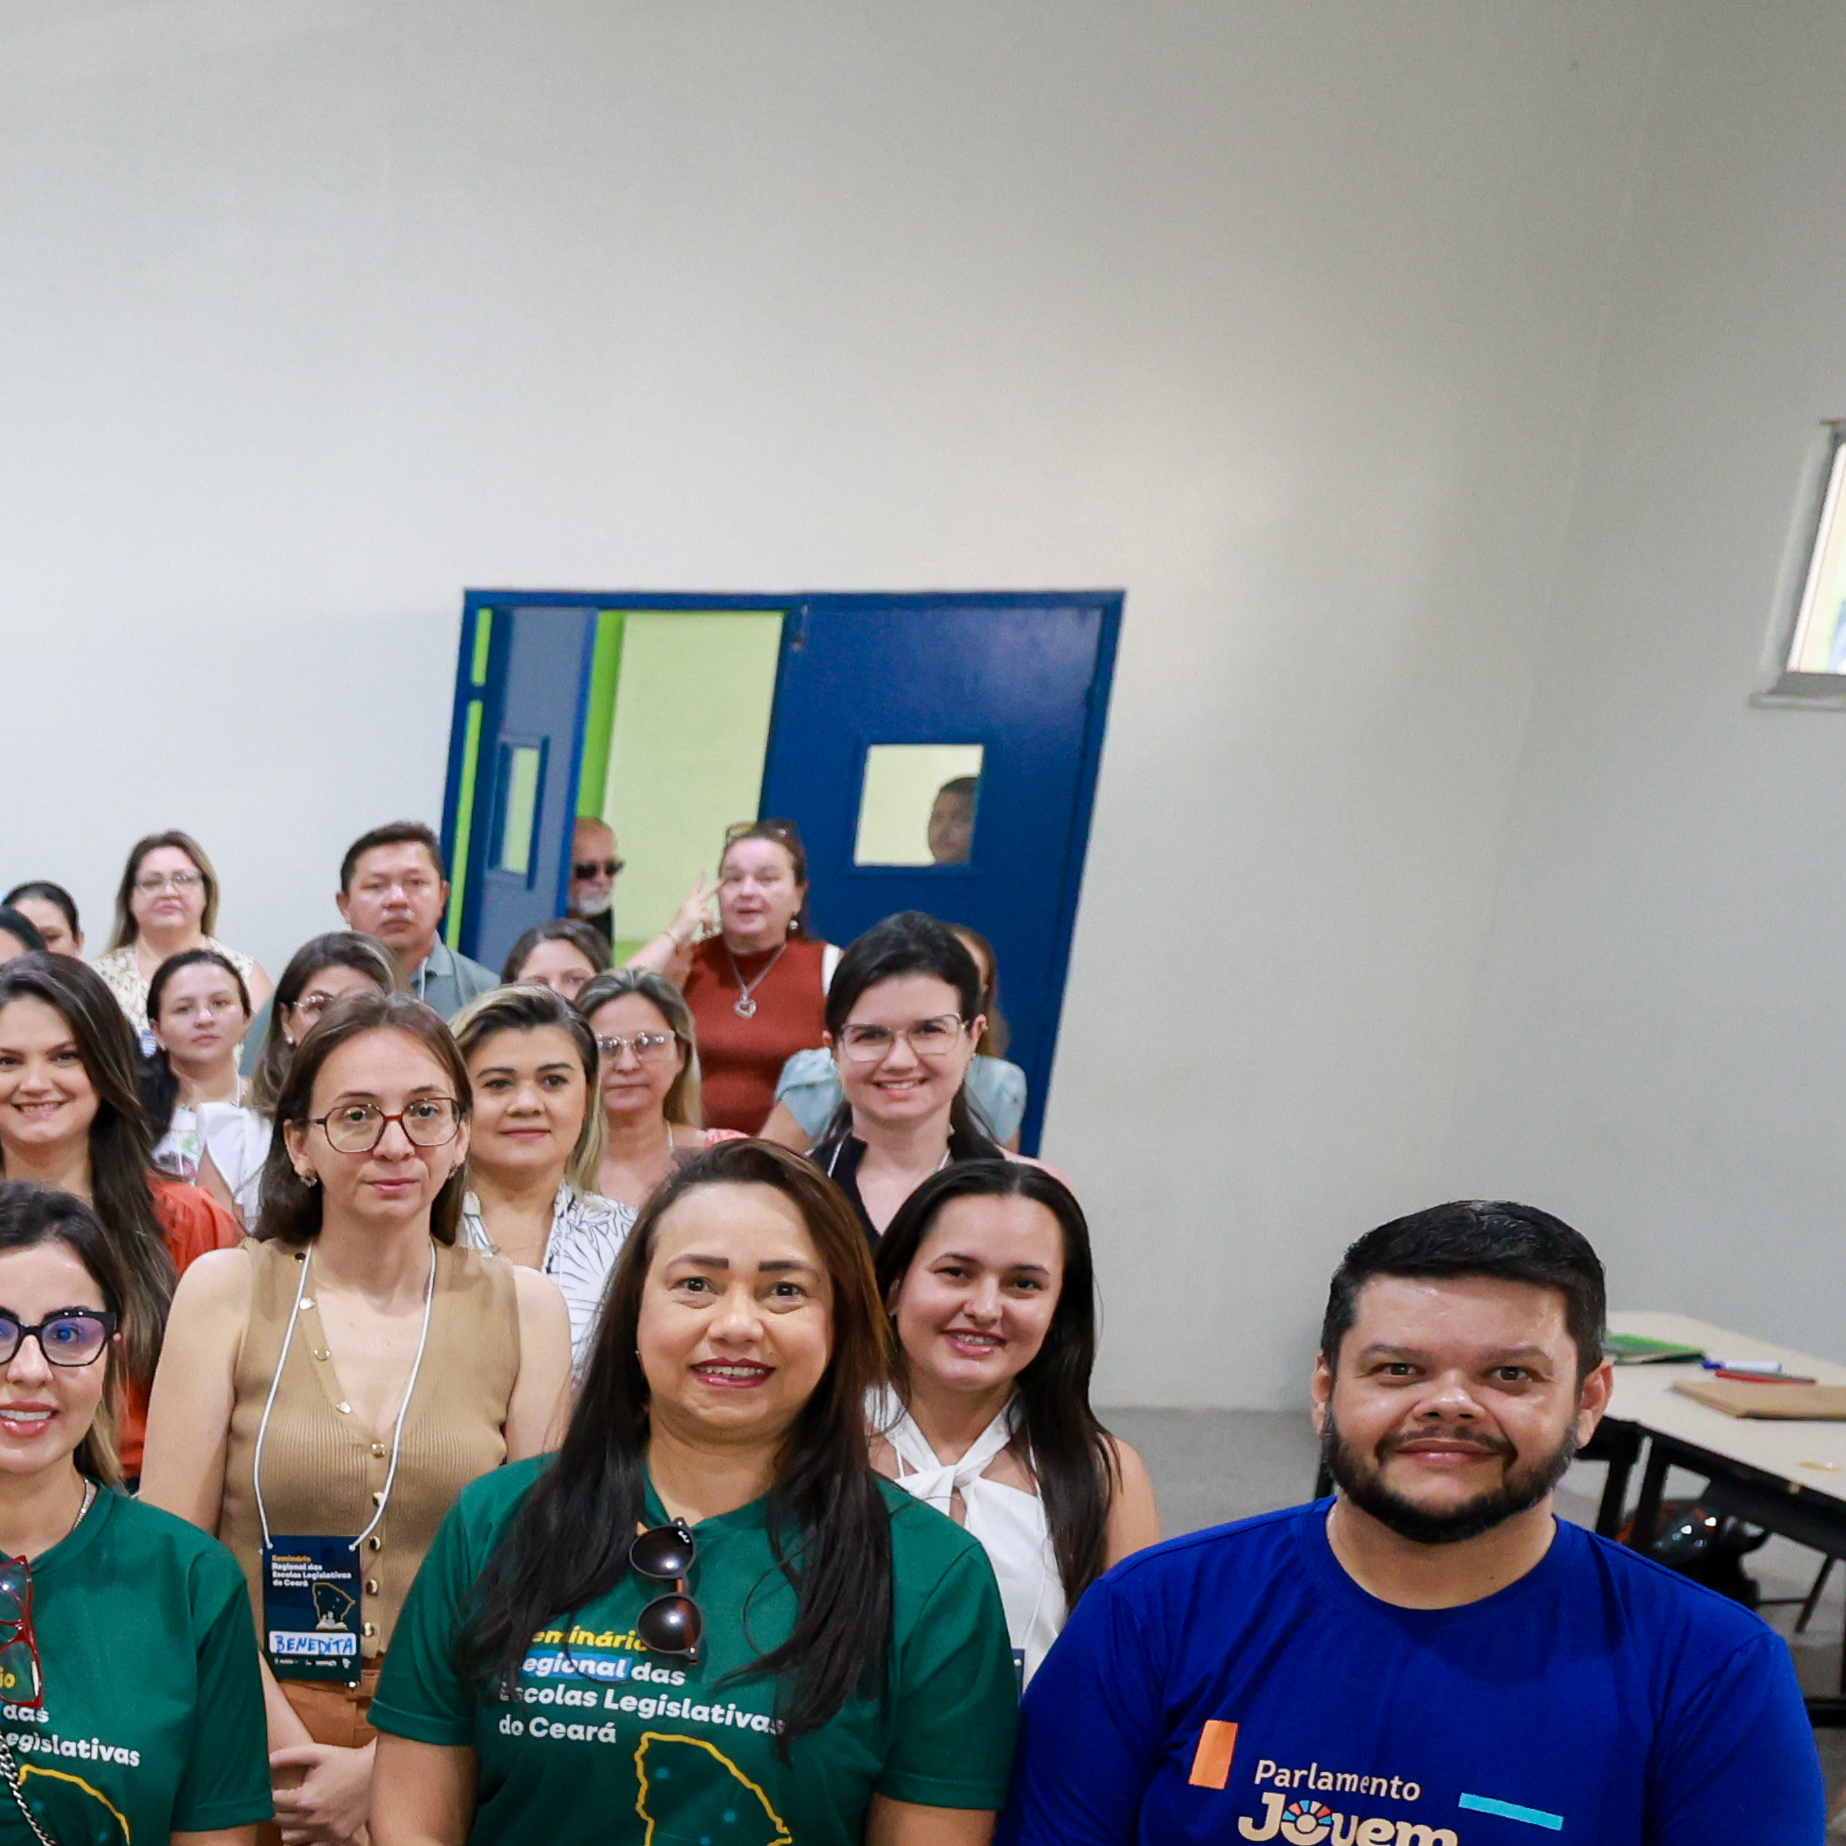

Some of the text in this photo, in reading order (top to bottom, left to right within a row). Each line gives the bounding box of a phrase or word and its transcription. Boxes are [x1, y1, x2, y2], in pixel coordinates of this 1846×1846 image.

[302, 1571, 352, 1580] Legislativas
[521, 1652, 686, 1686] egional das
[498, 1714, 617, 1744] do Ceará
[7, 1731, 141, 1767] egislativas
[1254, 1759, 1421, 1801] Parlamento
